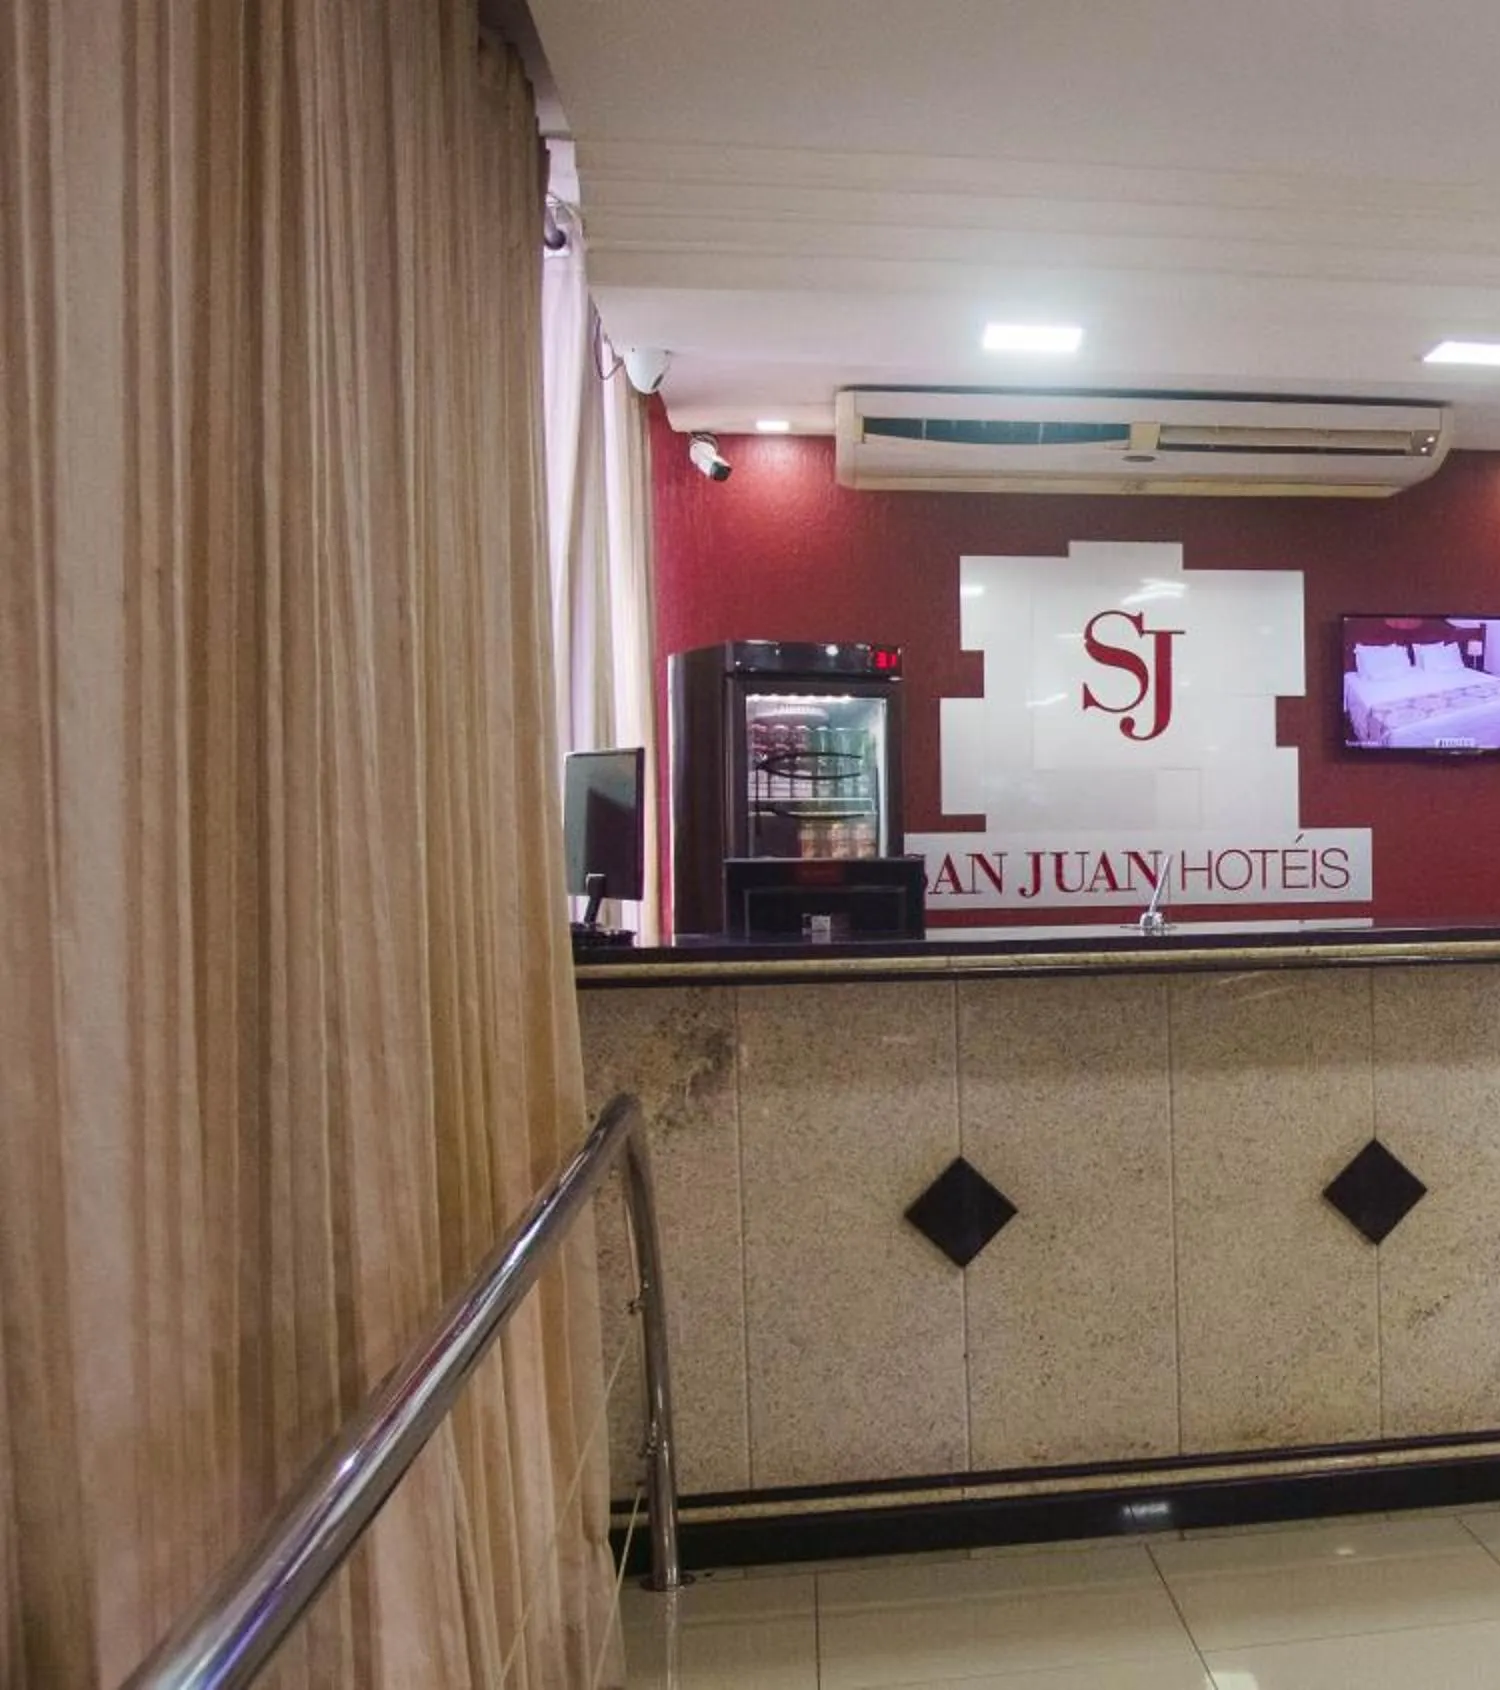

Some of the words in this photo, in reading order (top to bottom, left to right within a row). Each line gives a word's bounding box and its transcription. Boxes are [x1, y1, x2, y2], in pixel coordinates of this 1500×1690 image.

[1082, 610, 1186, 741] SJ
[908, 852, 1008, 896] AN
[1018, 851, 1173, 898] JUAN
[1180, 833, 1350, 891] HOTÉIS
